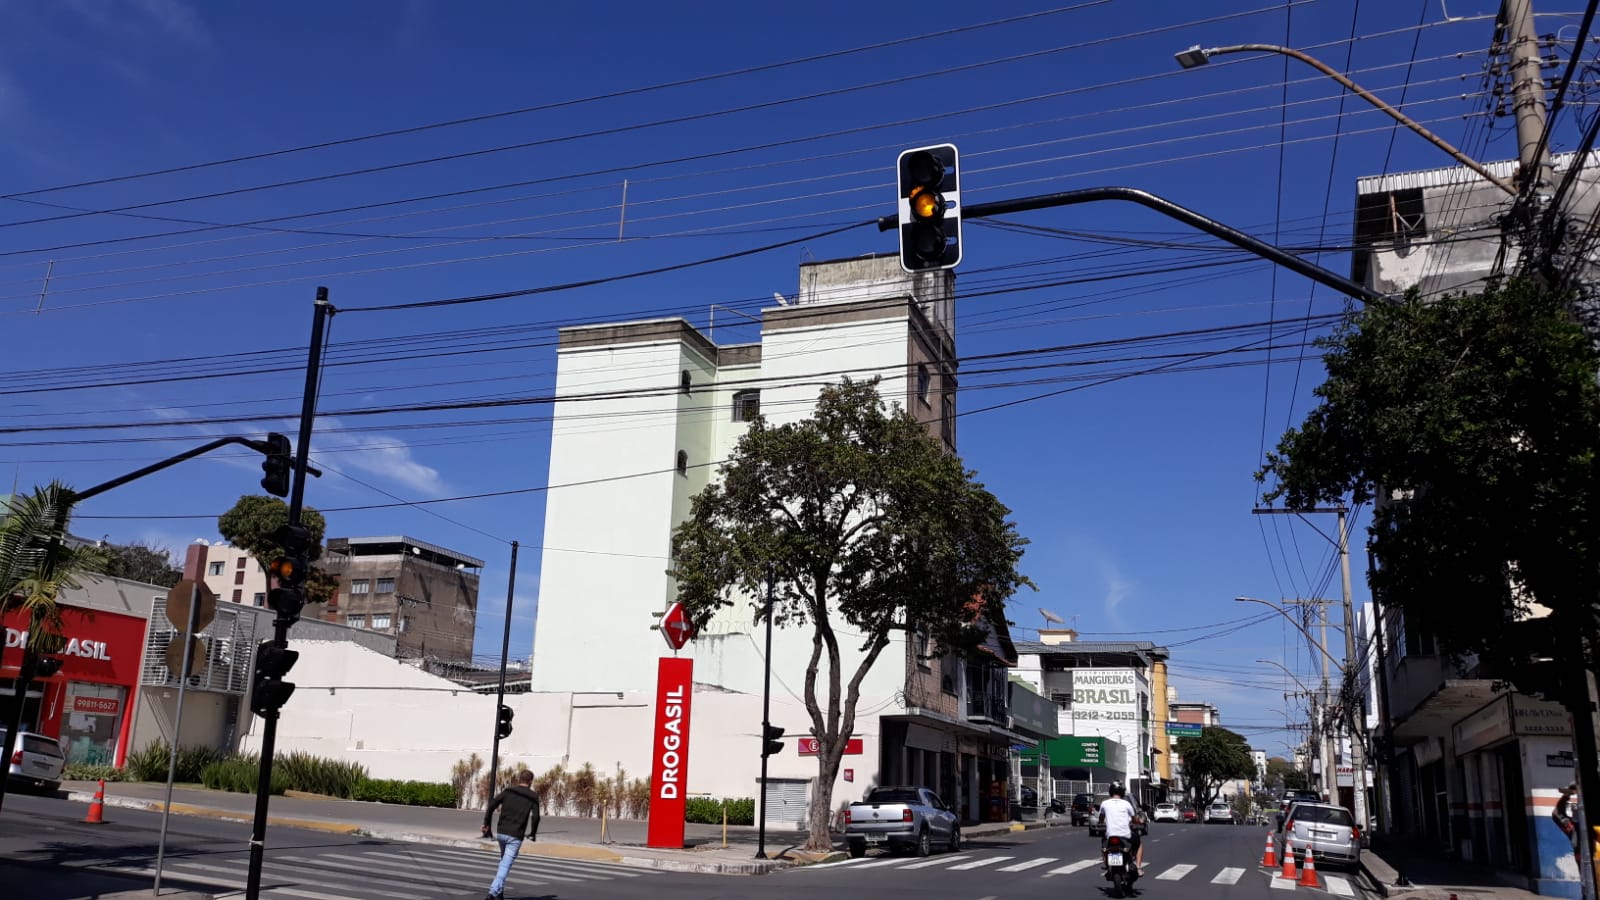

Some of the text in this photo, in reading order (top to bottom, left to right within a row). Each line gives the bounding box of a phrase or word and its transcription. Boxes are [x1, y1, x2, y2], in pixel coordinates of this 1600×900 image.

[5, 628, 112, 661] DASIL
[1074, 675, 1134, 685] MANGUEIRAS
[1074, 689, 1135, 704] BRASIL
[660, 684, 684, 799] DROGASIL
